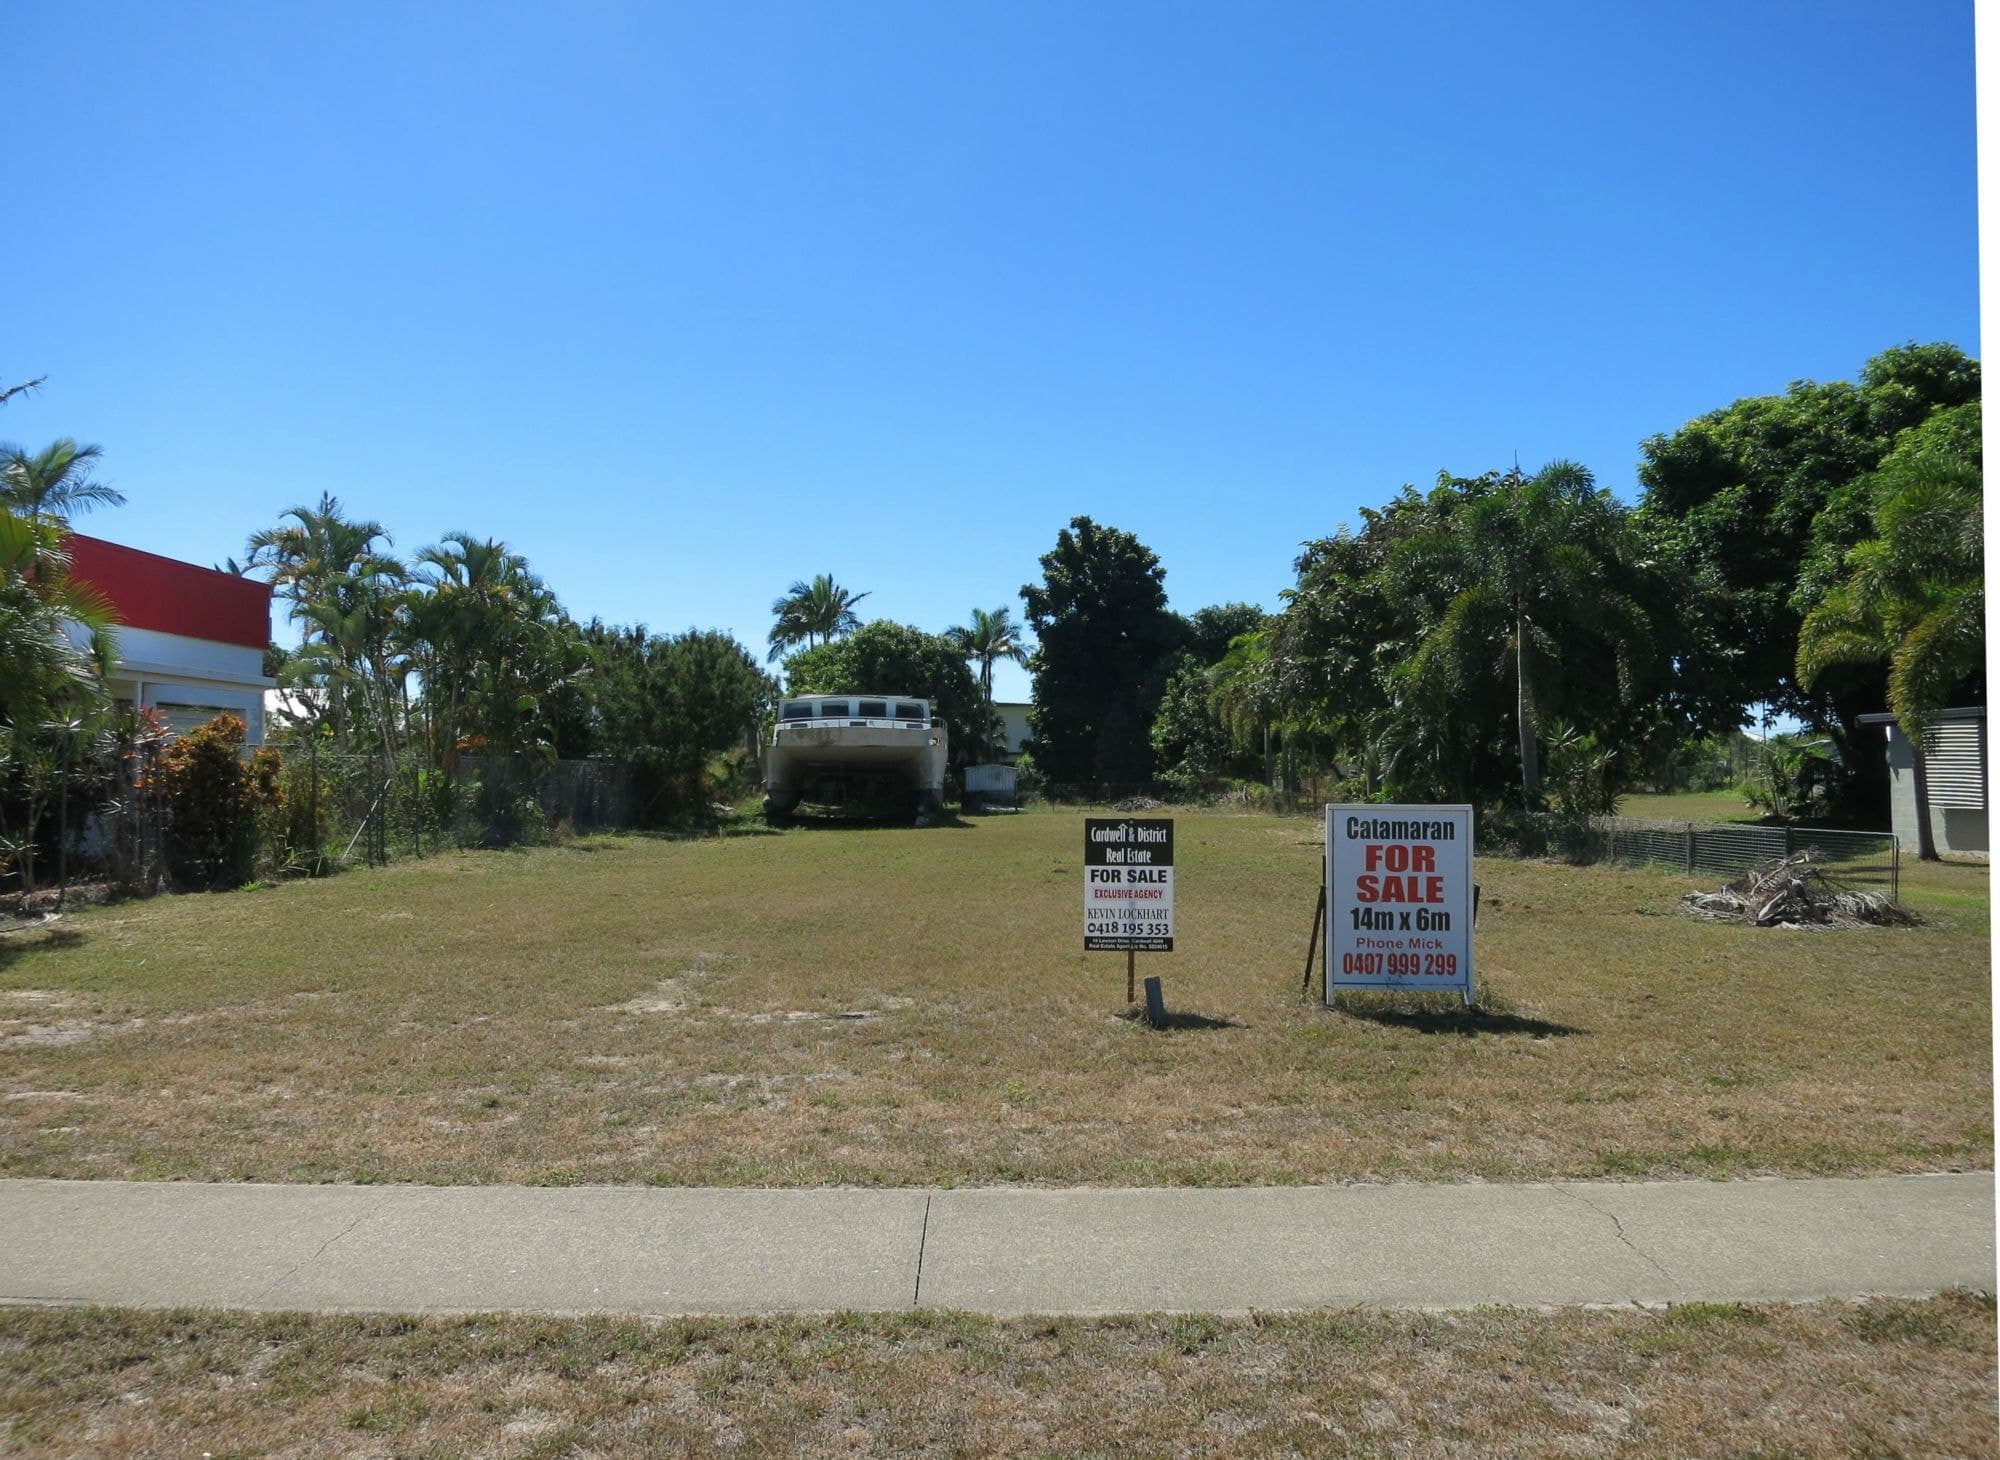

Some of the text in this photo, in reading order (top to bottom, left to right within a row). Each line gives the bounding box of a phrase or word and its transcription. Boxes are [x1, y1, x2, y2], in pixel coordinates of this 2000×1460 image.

[1091, 826, 1167, 843] Cardwell & District
[1346, 816, 1455, 840] Catamaran
[1106, 848, 1152, 863] Real Estate
[1366, 844, 1435, 872] FOR
[1090, 869, 1167, 883] FOR SALE
[1094, 890, 1163, 899] EXCLUSIVE AGENCY
[1356, 875, 1444, 904] SALE
[1088, 908, 1169, 920] KEVIN LOCKHART
[1350, 908, 1450, 931] 14m x 6m
[1088, 922, 1169, 936] 0418 195 353
[1356, 938, 1443, 950] Phone Mick
[1343, 953, 1457, 976] 0407 999 299
